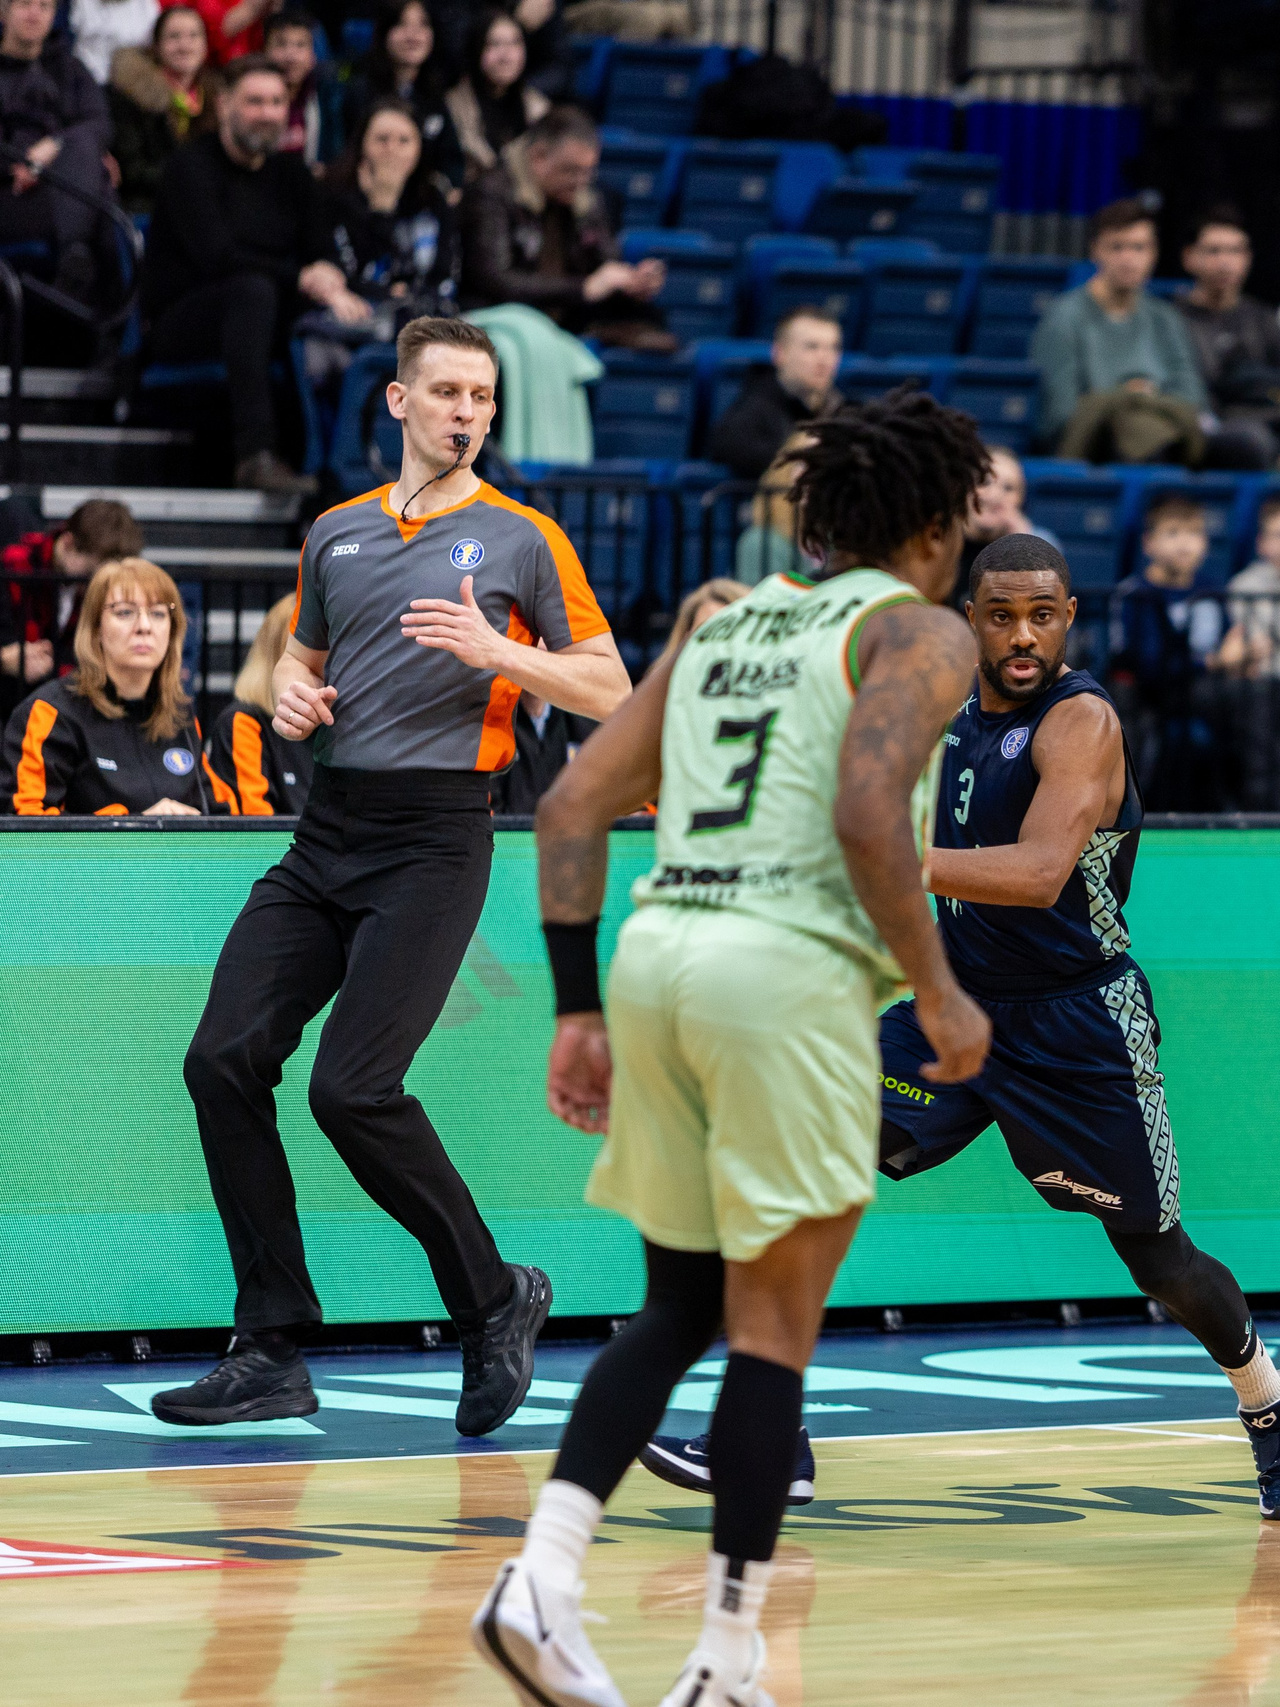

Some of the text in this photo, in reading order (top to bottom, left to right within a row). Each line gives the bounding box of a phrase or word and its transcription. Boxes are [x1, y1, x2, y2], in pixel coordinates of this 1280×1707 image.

[332, 544, 360, 557] ZEDO
[684, 709, 779, 838] 3
[954, 767, 975, 826] 3
